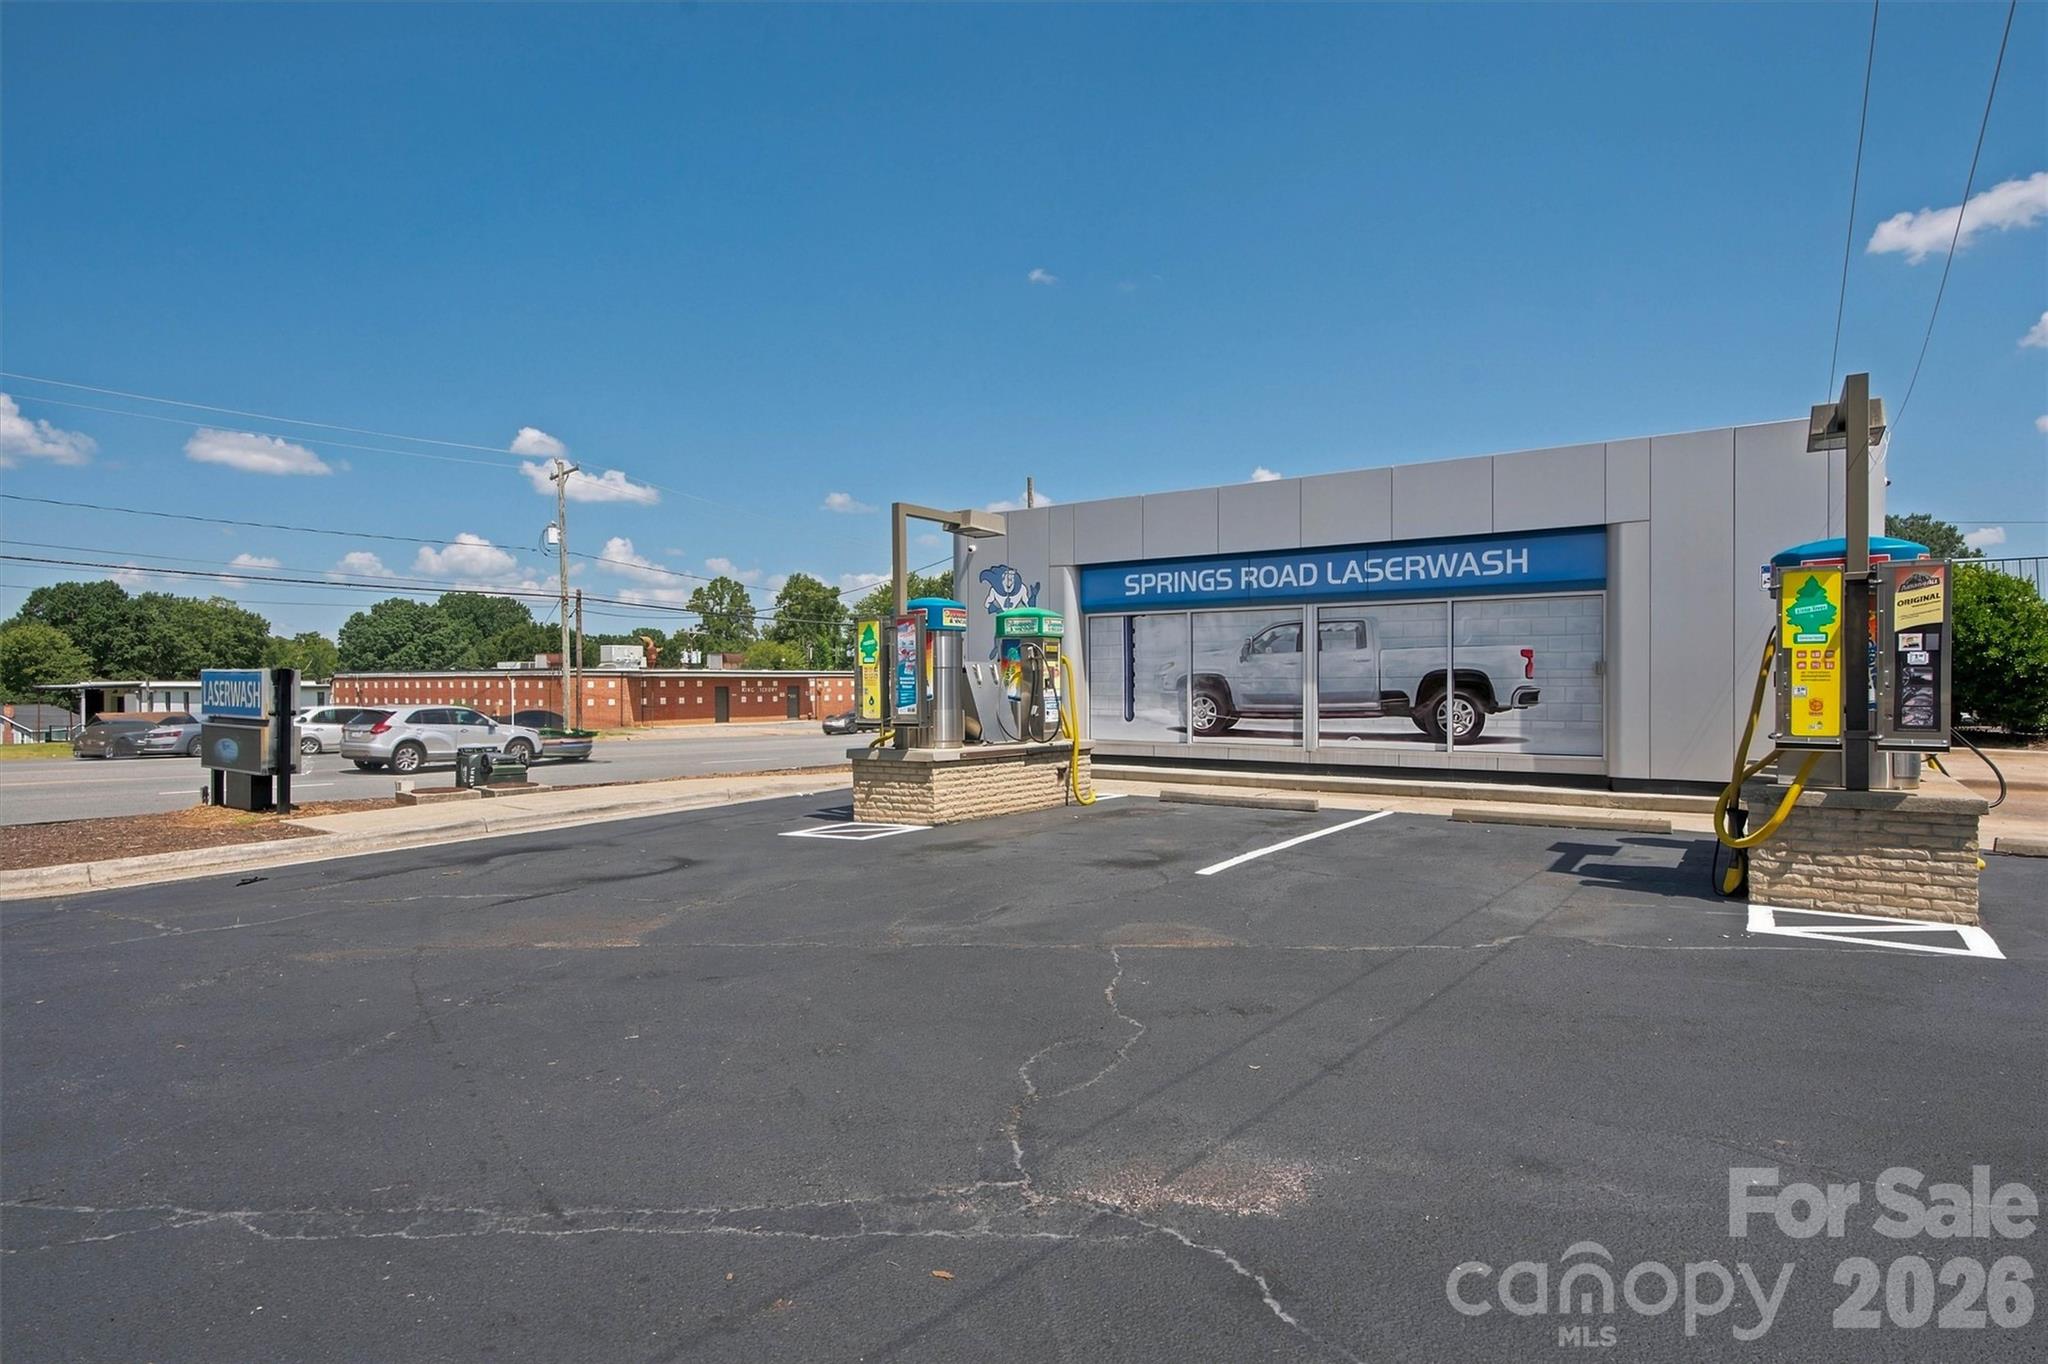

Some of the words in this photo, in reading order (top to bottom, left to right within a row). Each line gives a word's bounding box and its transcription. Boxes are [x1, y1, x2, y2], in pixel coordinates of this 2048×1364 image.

[1124, 568, 1233, 596] SPRINGS
[1241, 562, 1318, 589] ROAD
[1326, 548, 1529, 585] LASERWASH
[1897, 592, 1941, 607] ORIGINAL
[203, 680, 261, 709] LASERWASH
